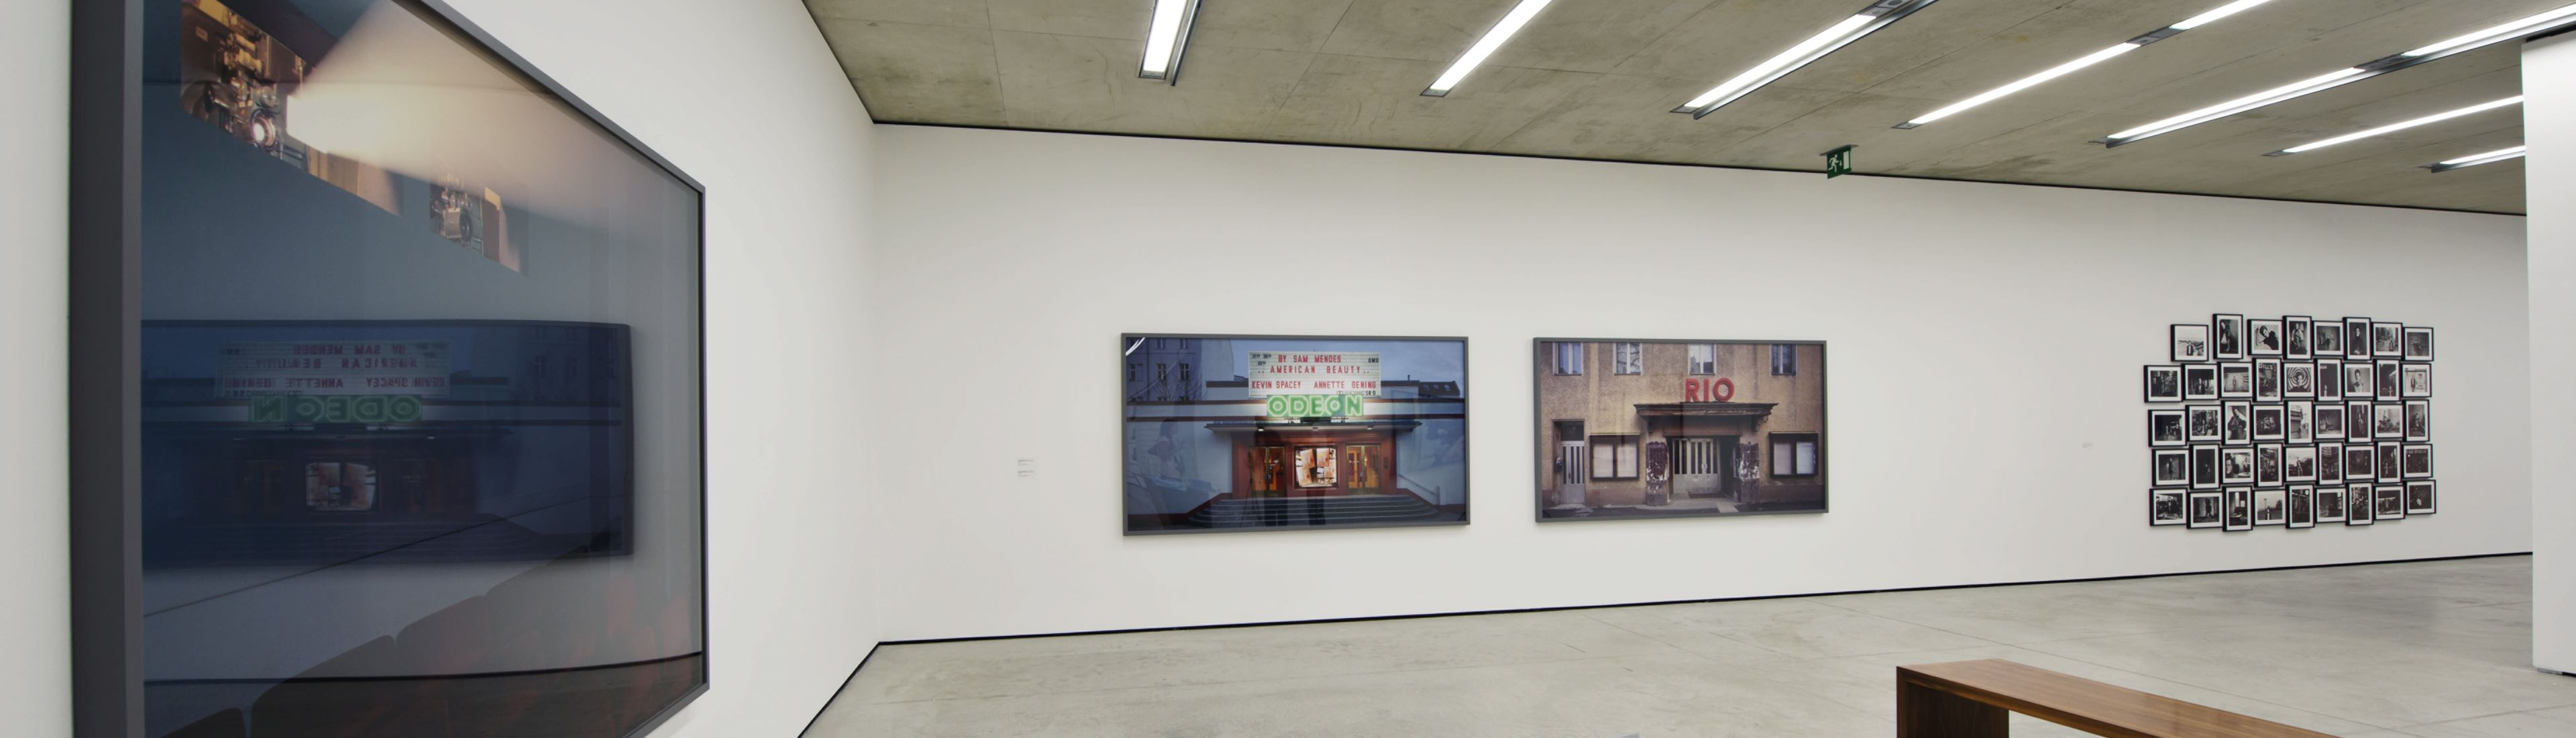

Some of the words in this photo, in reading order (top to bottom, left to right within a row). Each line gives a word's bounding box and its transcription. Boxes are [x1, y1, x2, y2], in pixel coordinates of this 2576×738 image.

[1278, 354, 1287, 363] BY
[1293, 354, 1308, 363] SAM
[1314, 354, 1342, 363] MENDES
[1251, 380, 1272, 389] KEVIN
[1276, 380, 1301, 389] SPACEY
[1313, 381, 1345, 389] ANNETTE
[1352, 380, 1377, 389] BENING
[1684, 377, 1735, 403] RIO
[1267, 394, 1362, 417] ODEON
